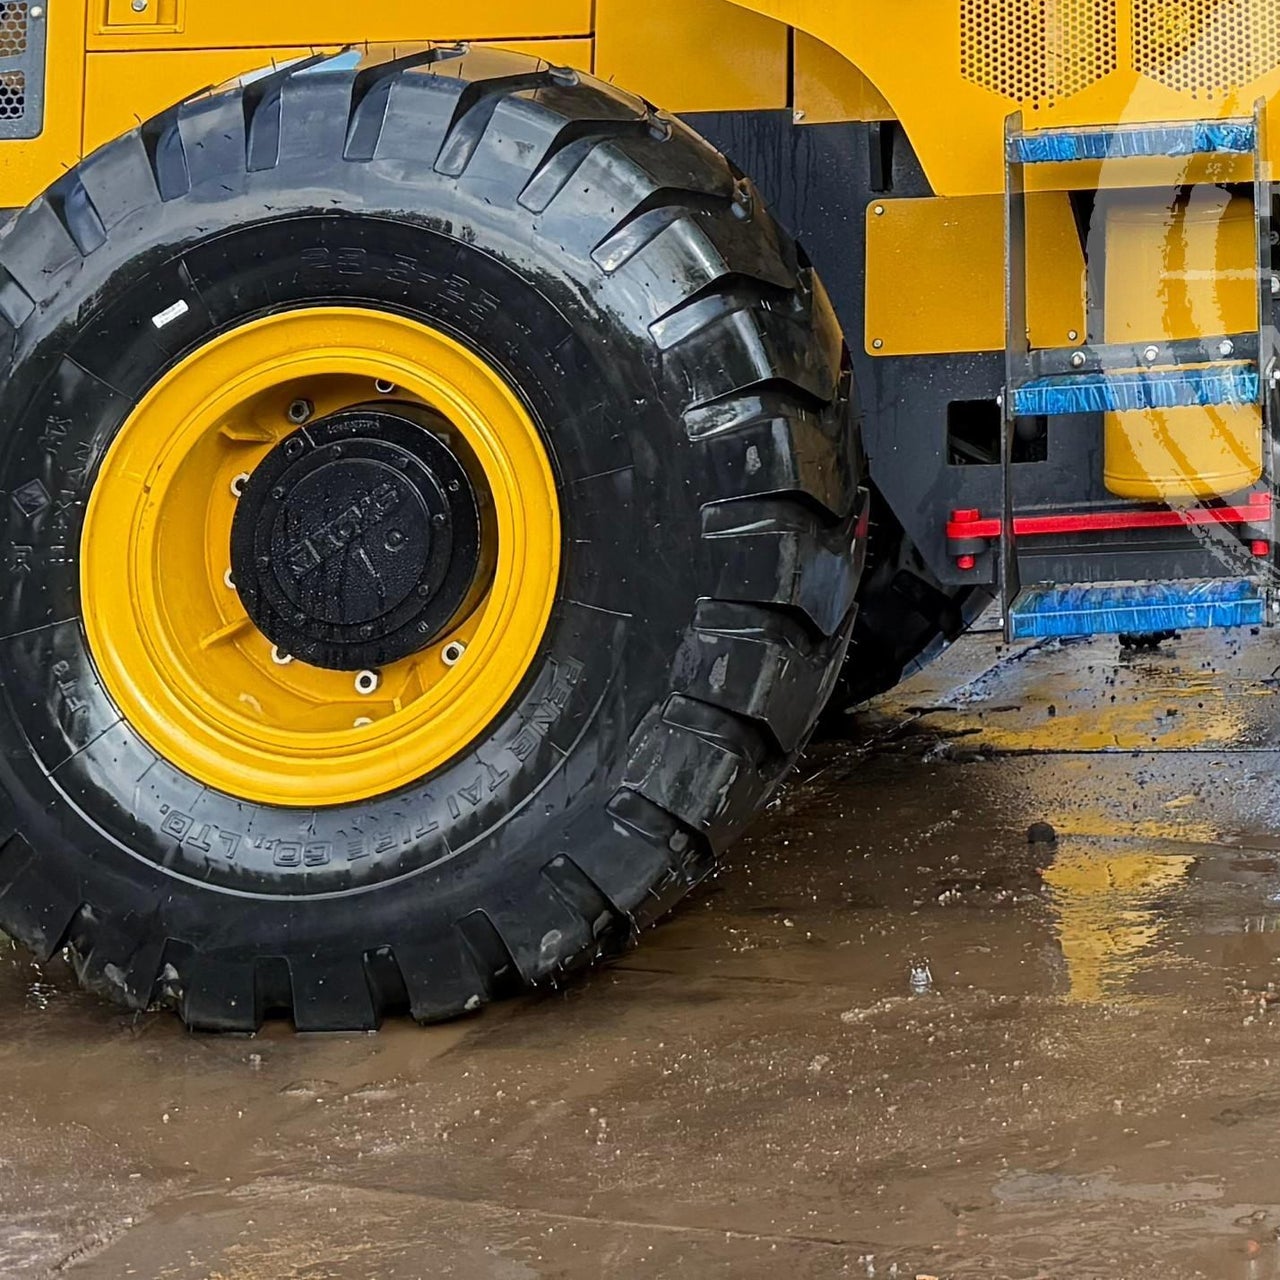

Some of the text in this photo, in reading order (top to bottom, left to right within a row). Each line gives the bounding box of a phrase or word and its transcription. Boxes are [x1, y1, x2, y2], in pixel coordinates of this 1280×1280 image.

[508, 656, 587, 762] FENG
[447, 769, 511, 820] TAI
[346, 819, 439, 862] TIRE
